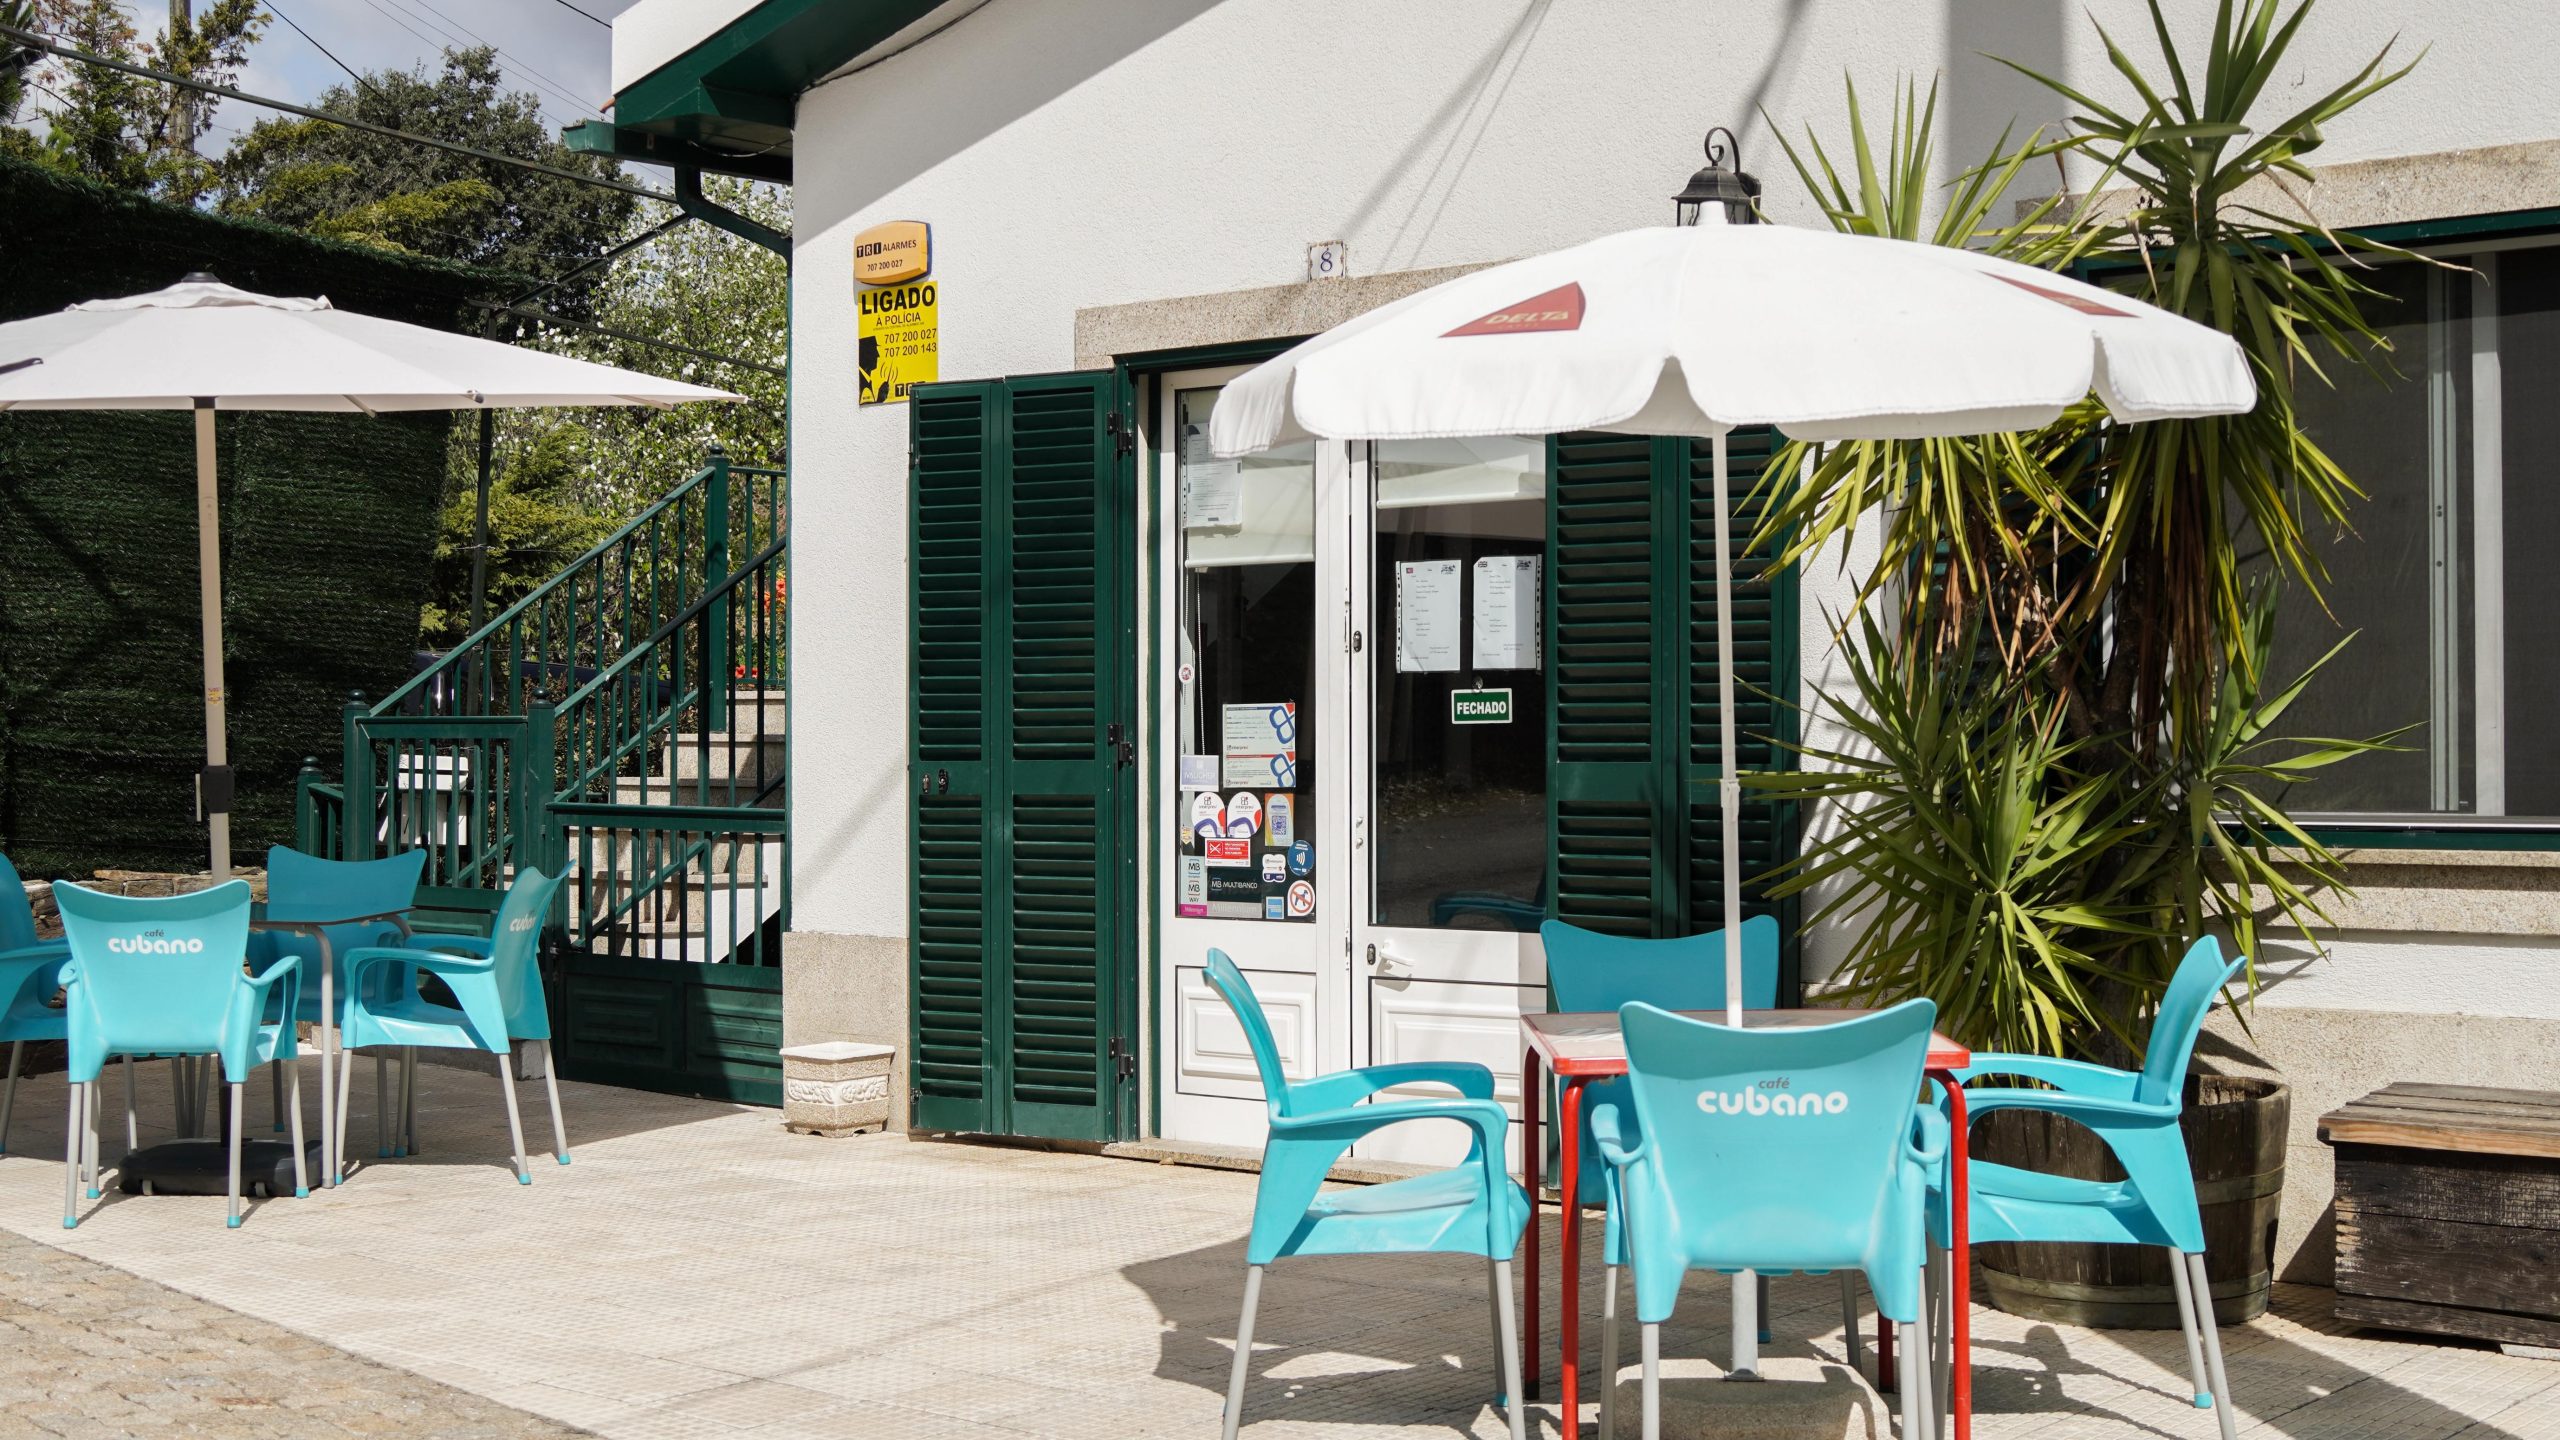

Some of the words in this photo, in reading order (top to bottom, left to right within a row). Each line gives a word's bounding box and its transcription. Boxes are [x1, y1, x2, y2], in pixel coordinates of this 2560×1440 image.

[857, 242, 882, 258] TRI
[882, 239, 917, 252] ALARMES
[867, 263, 878, 272] 707
[879, 261, 890, 270] 200
[891, 259, 903, 268] 027
[1320, 248, 1333, 272] 8
[861, 285, 936, 315] LIGADO
[885, 311, 921, 326] POLÍCIA
[1486, 311, 1569, 324] DELTA
[884, 333, 900, 344] 707
[902, 331, 918, 342] 200
[920, 328, 937, 340] 027
[884, 347, 900, 358] 707
[902, 344, 918, 356] 200
[921, 342, 937, 353] 143
[1456, 701, 1507, 715] FECHADO
[1188, 863, 1200, 871] MB
[1188, 884, 1200, 892] MB
[1222, 881, 1258, 889] MULTIBANCO
[144, 929, 165, 937] café
[108, 934, 203, 954] cubano
[1758, 1077, 1790, 1089] café
[1696, 1085, 1849, 1117] cubano
